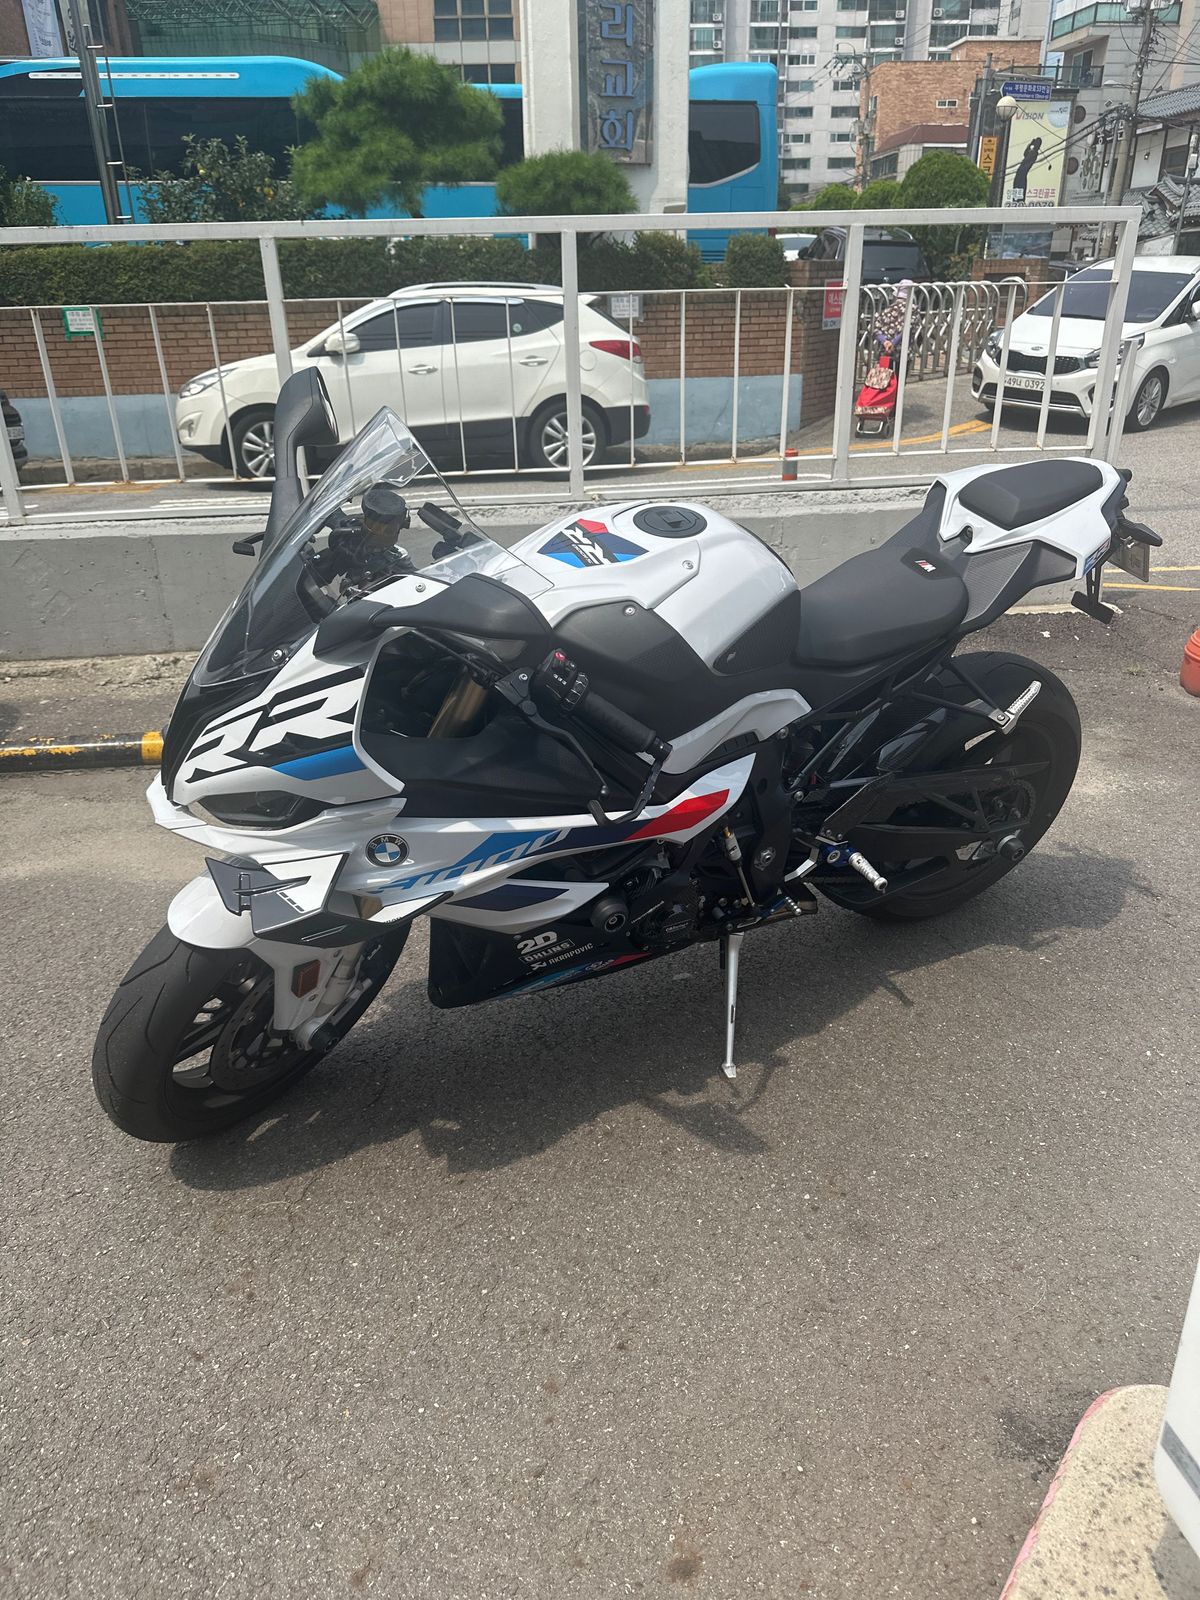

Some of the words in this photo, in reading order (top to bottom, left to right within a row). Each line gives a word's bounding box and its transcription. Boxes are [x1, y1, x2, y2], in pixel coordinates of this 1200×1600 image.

[600, 3, 634, 150] 리교회
[1024, 379, 1045, 391] 0392
[516, 931, 558, 955] 2D
